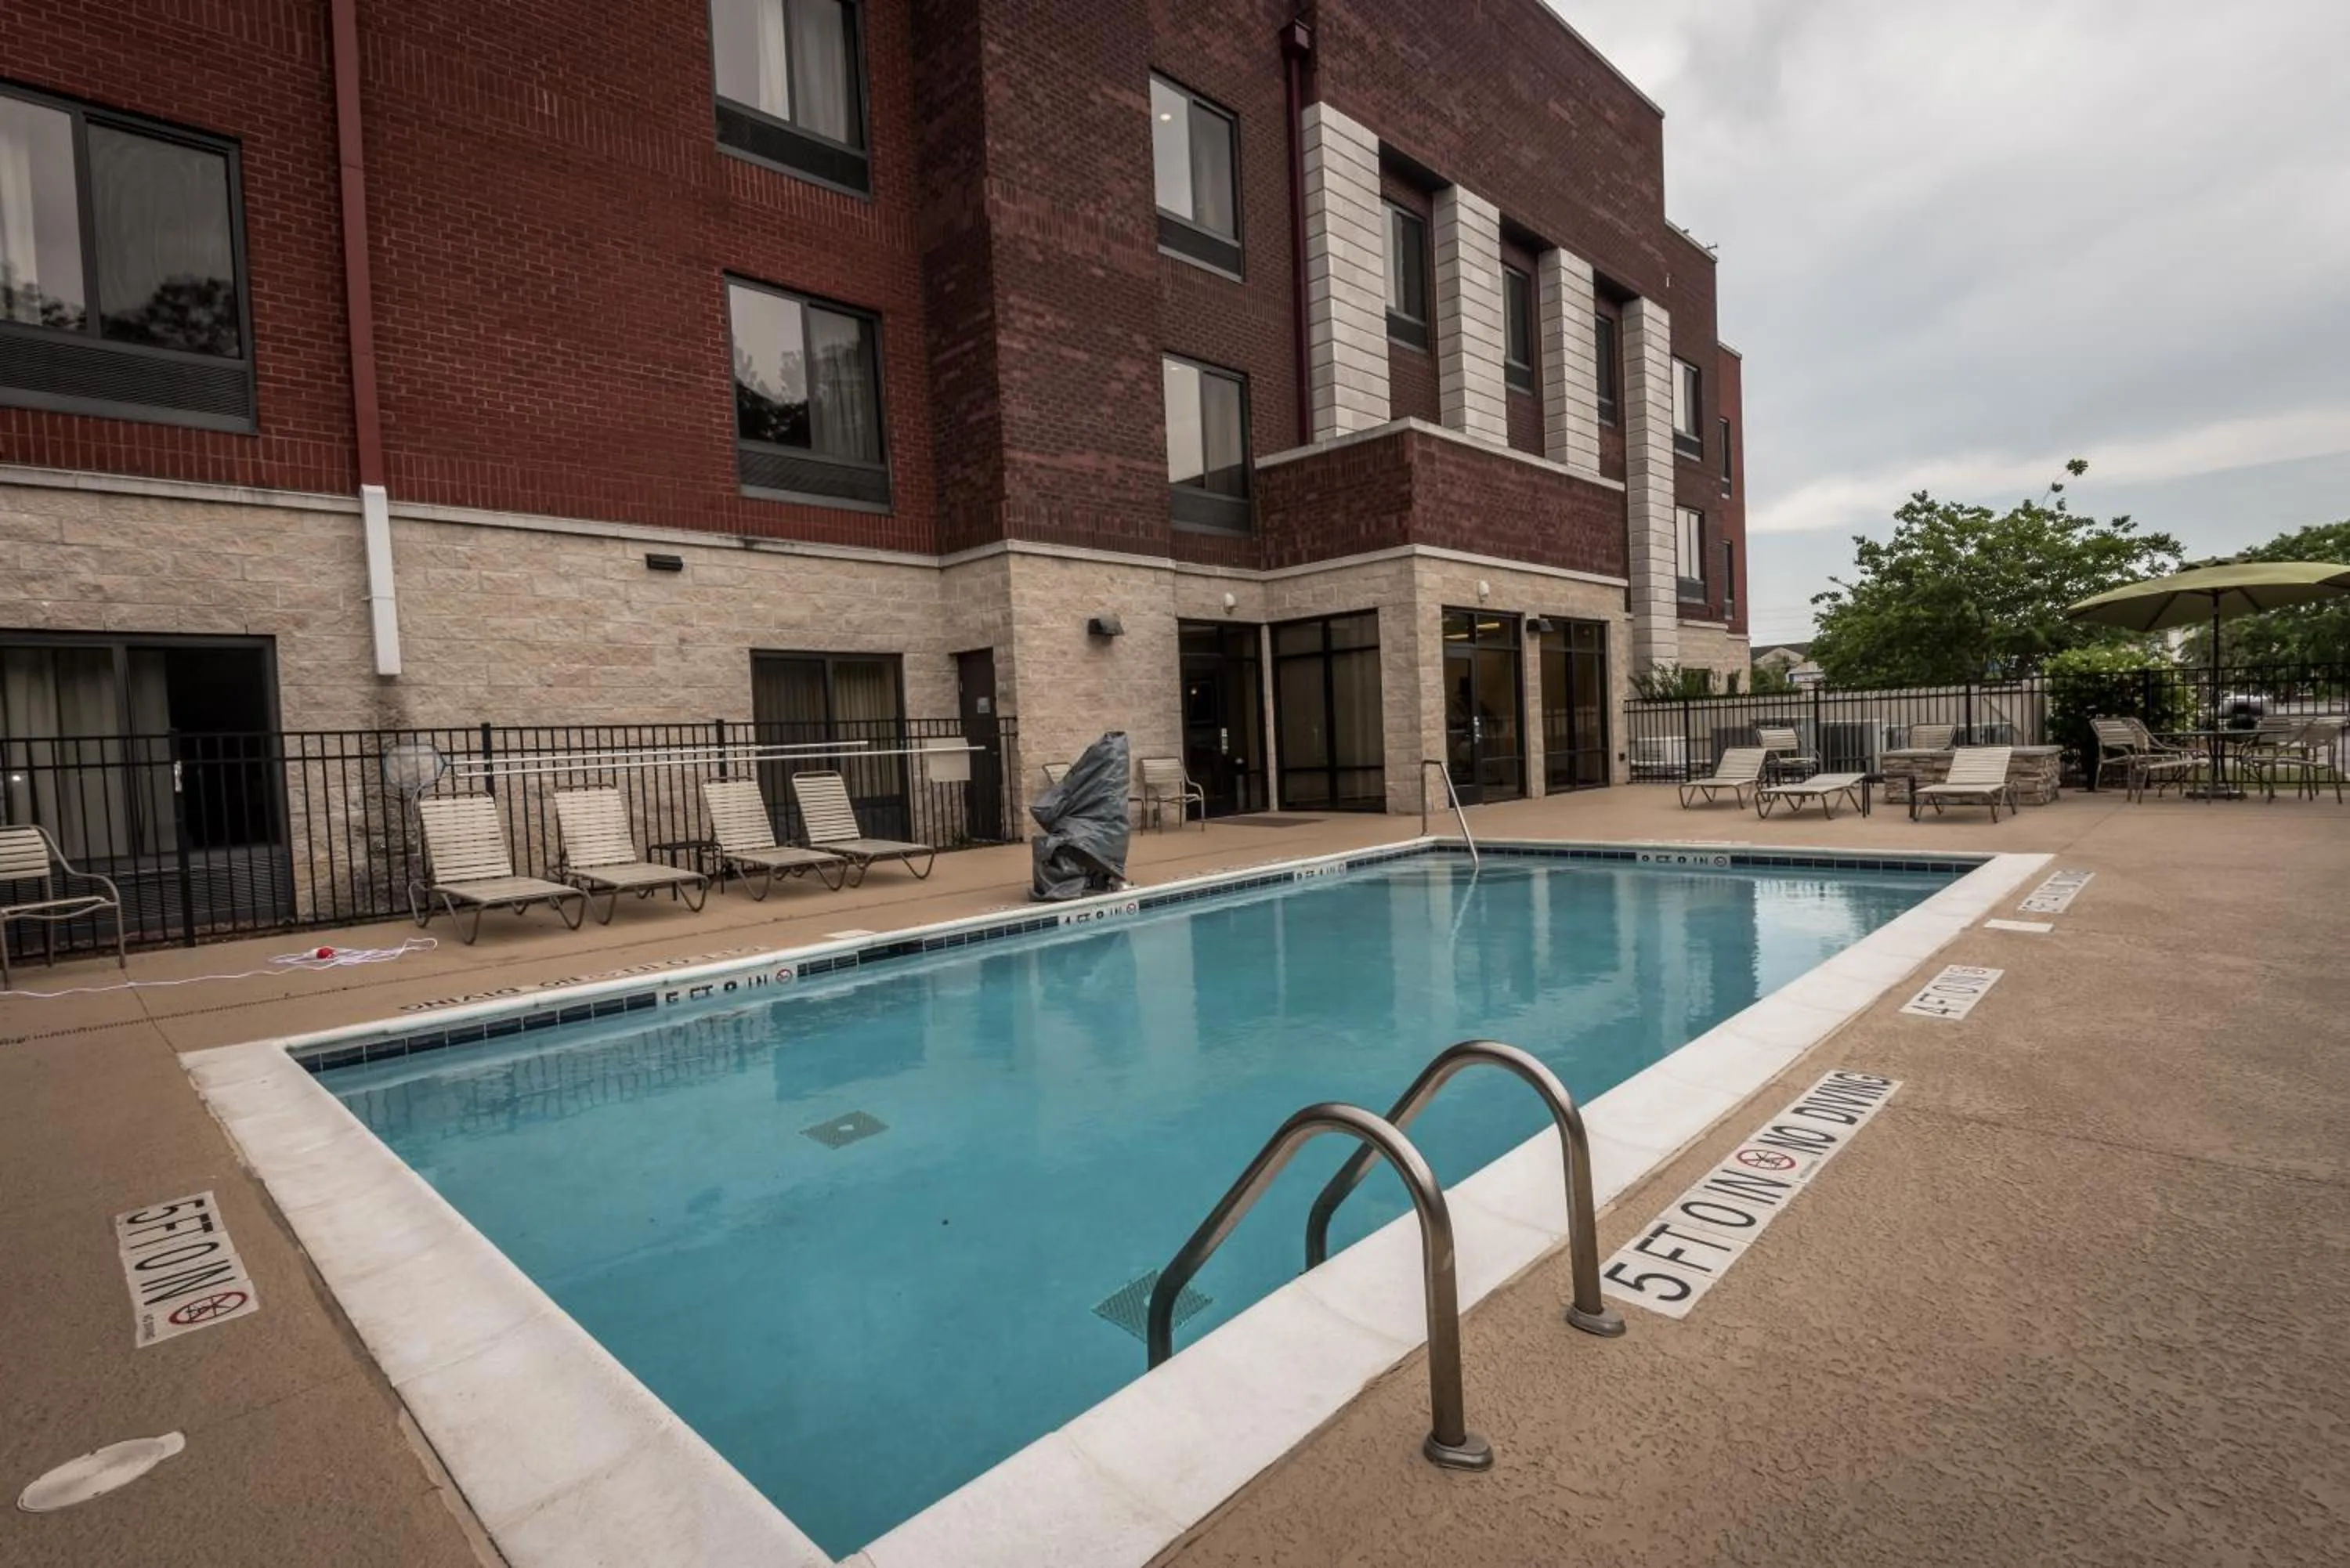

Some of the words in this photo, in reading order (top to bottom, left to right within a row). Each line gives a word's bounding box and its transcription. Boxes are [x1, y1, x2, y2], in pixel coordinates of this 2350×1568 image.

[1791, 1072, 1892, 1125] DIVING
[1757, 1125, 1838, 1155] NO
[1703, 1169, 1793, 1206] IN
[126, 1198, 205, 1224] 5
[127, 1213, 214, 1250] FT
[1634, 1223, 1732, 1274] FT
[140, 1259, 237, 1306] IN
[1603, 1262, 1692, 1302] 5
